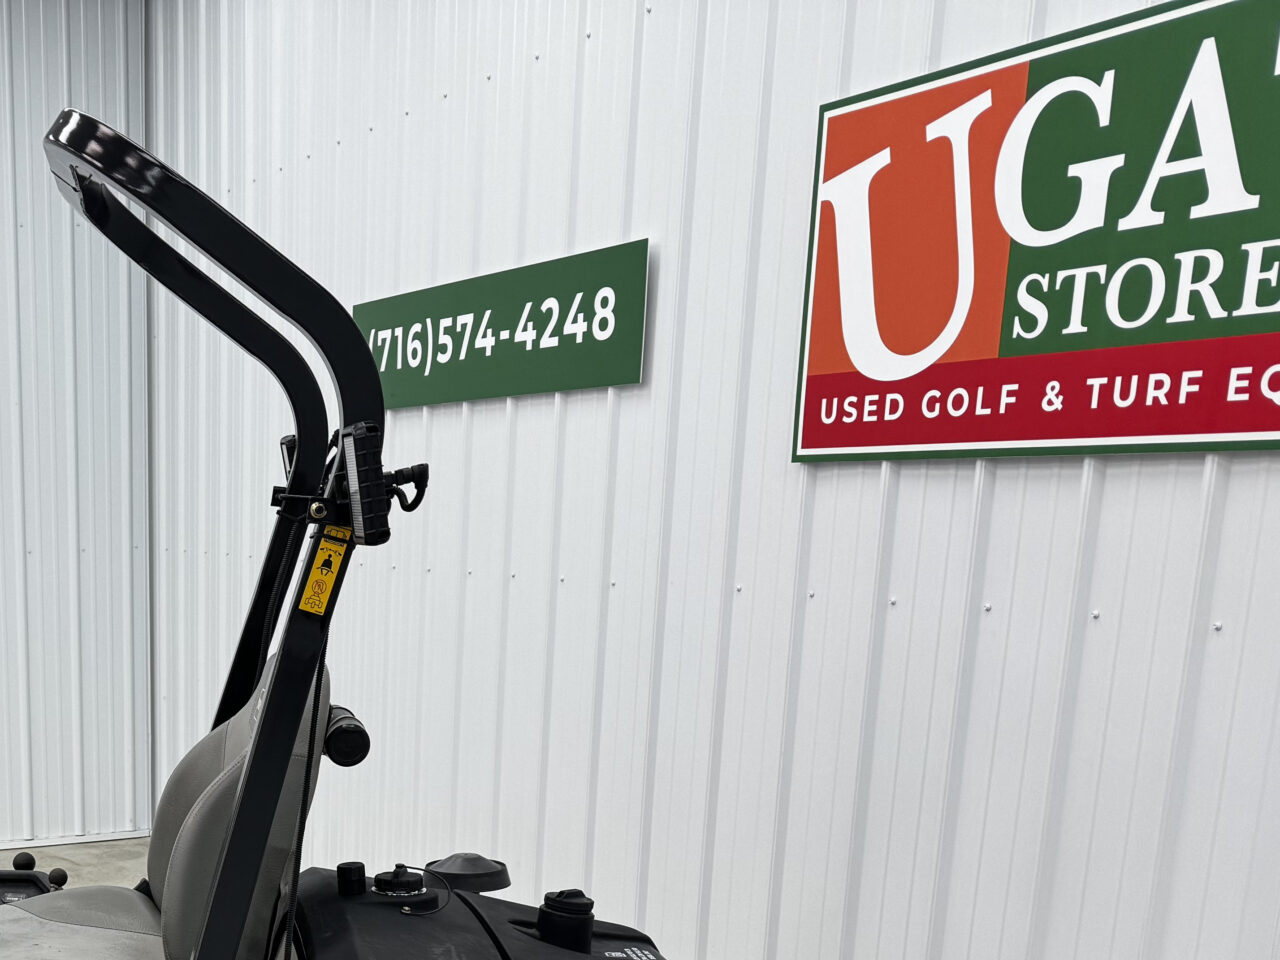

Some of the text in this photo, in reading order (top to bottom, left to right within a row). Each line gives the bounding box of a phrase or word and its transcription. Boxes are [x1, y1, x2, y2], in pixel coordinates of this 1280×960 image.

[819, 24, 1280, 382] UGA
[369, 286, 616, 377] (716)574-4248
[820, 392, 905, 425] USED
[921, 383, 1019, 419] GOLF
[1041, 380, 1064, 412] &
[1086, 369, 1204, 410] TURF
